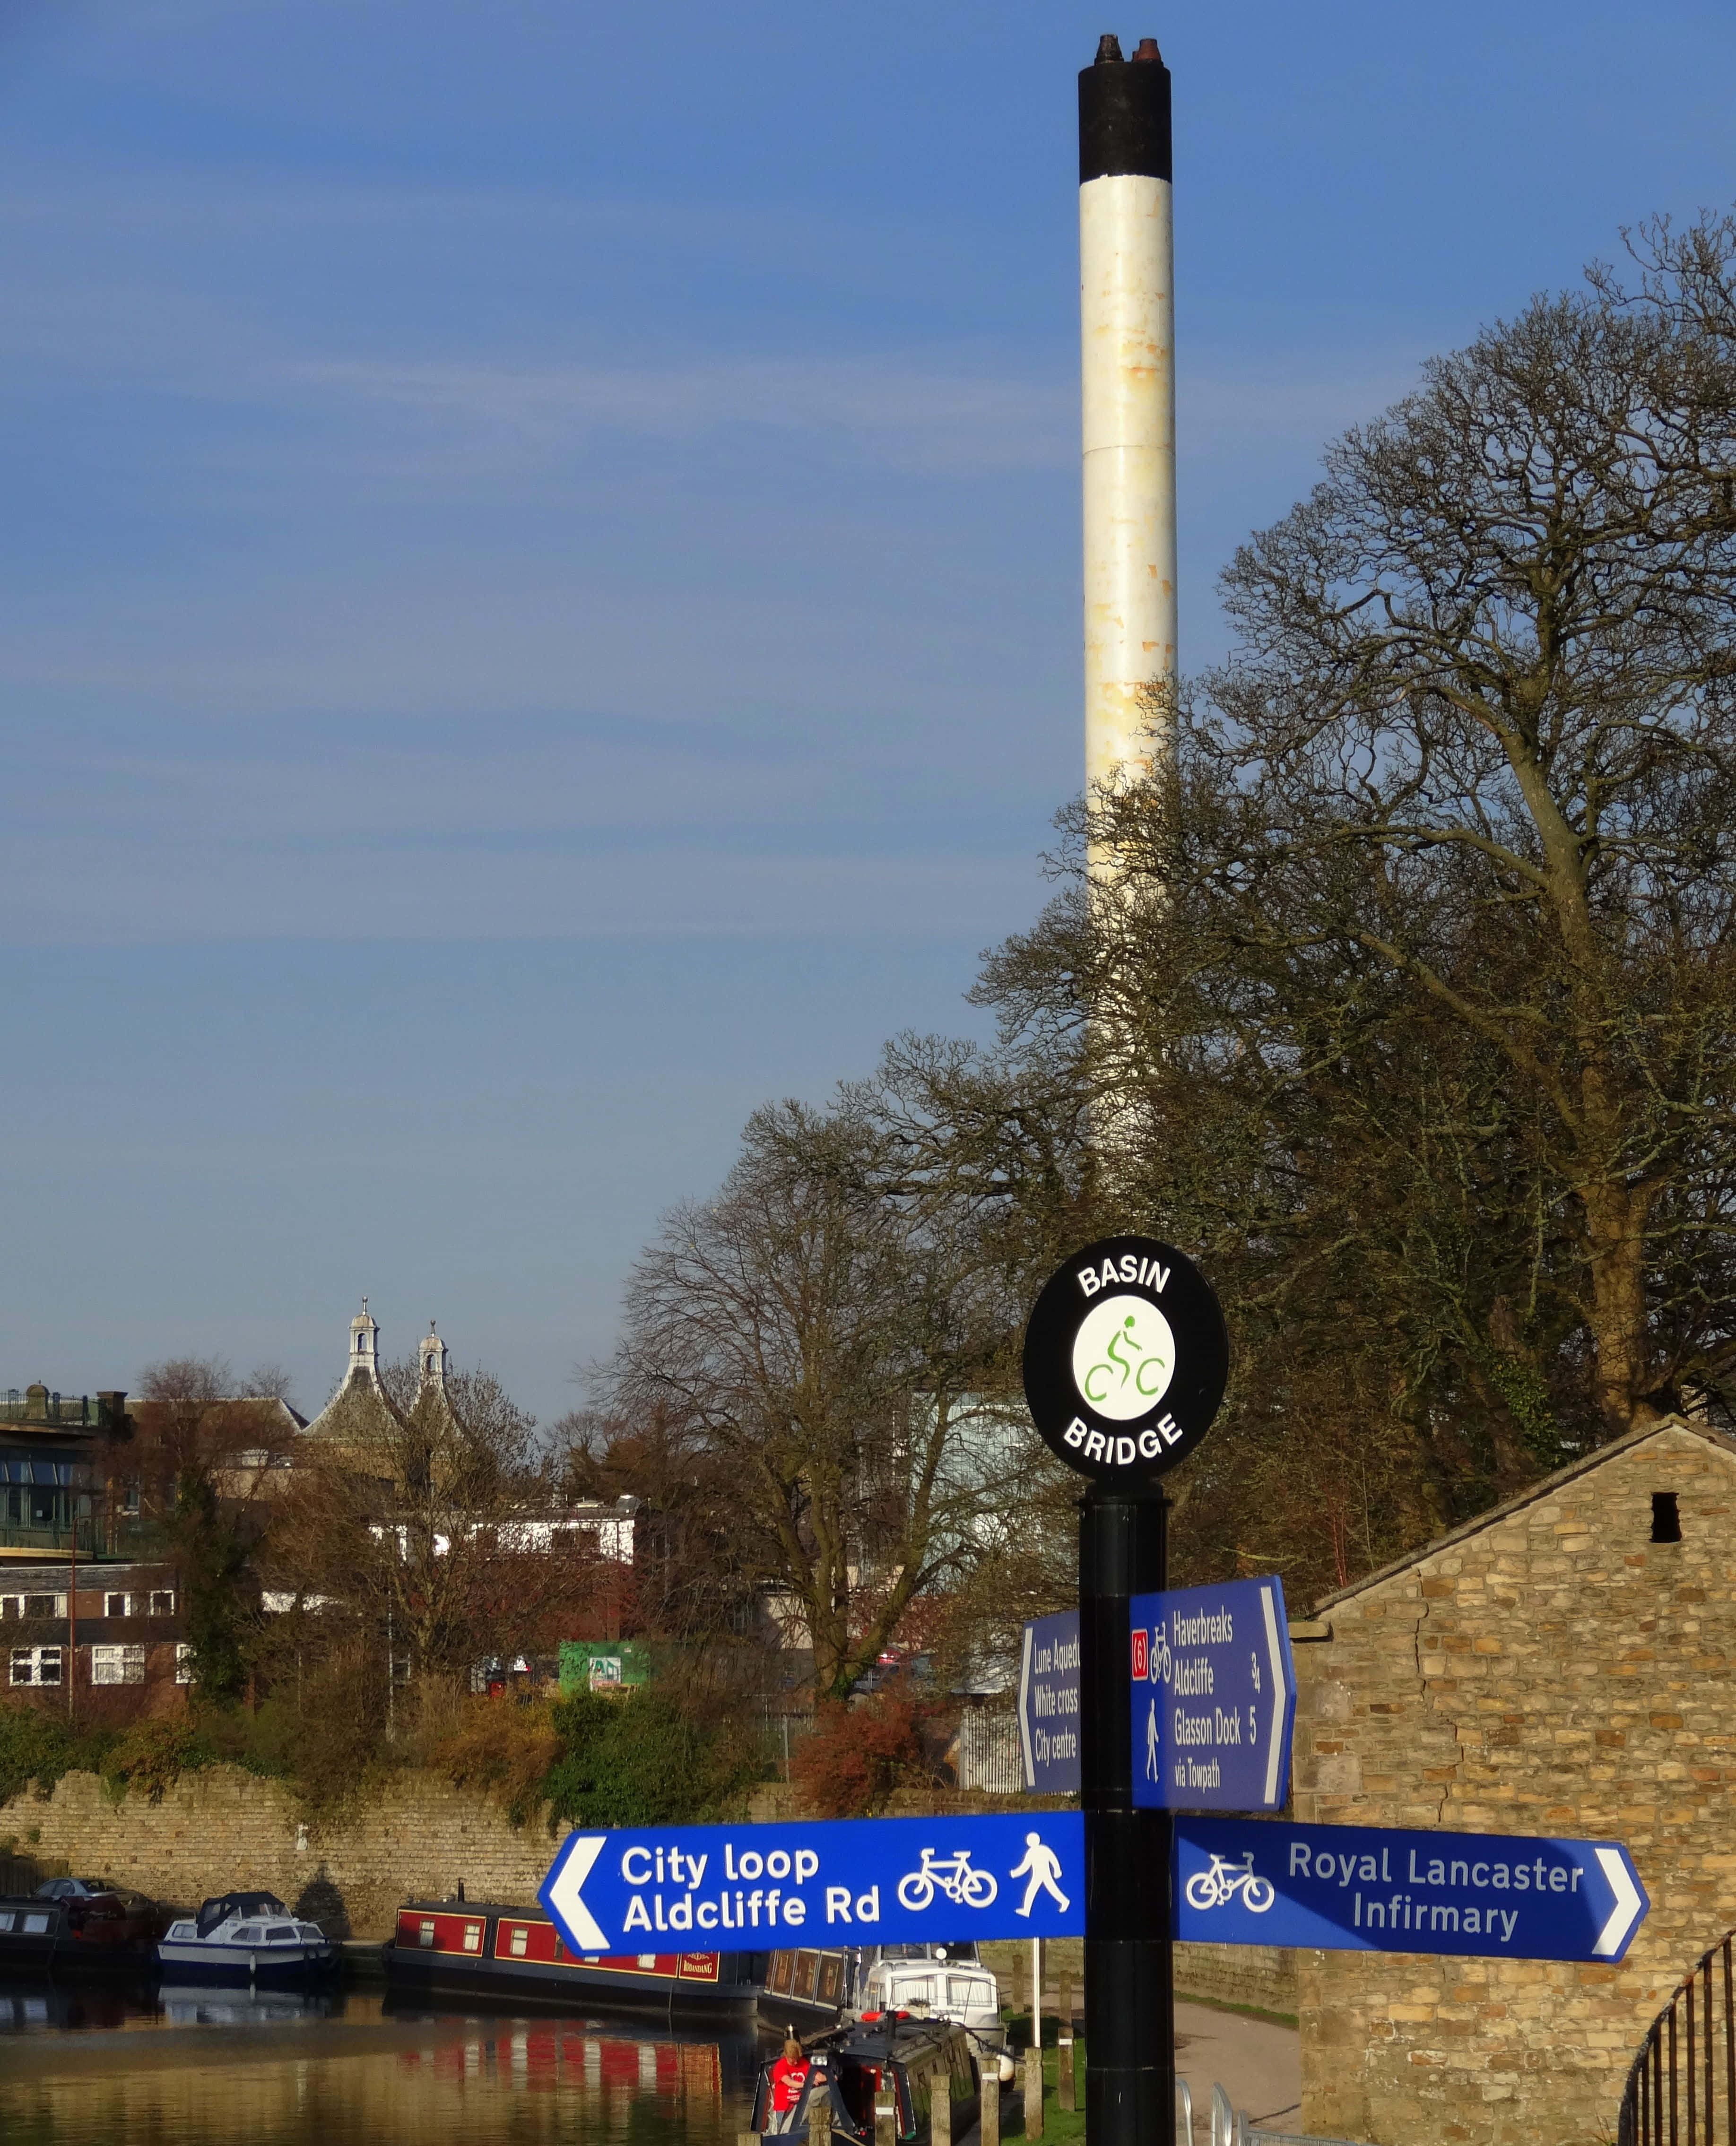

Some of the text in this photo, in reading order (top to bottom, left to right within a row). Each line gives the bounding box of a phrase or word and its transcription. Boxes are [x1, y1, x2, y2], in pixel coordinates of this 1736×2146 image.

[1077, 1255, 1171, 1297] BASIN
[1064, 1413, 1183, 1465] BRIDGE
[1173, 1605, 1233, 1647] Haverbreaks
[1034, 1642, 1051, 1675] Lune
[1174, 1657, 1214, 1696] Aldcliffe
[1034, 1684, 1078, 1717] White cross
[1035, 1726, 1076, 1767] City centre
[1175, 1705, 1257, 1746] Glasson Dock 5
[1175, 1757, 1220, 1794] via Towpath
[621, 1843, 819, 1890] City loop
[1290, 1843, 1584, 1892] Royal Lancaster
[623, 1885, 879, 1932] Aldcliffe Rd
[1355, 1893, 1518, 1941] Infirmary
